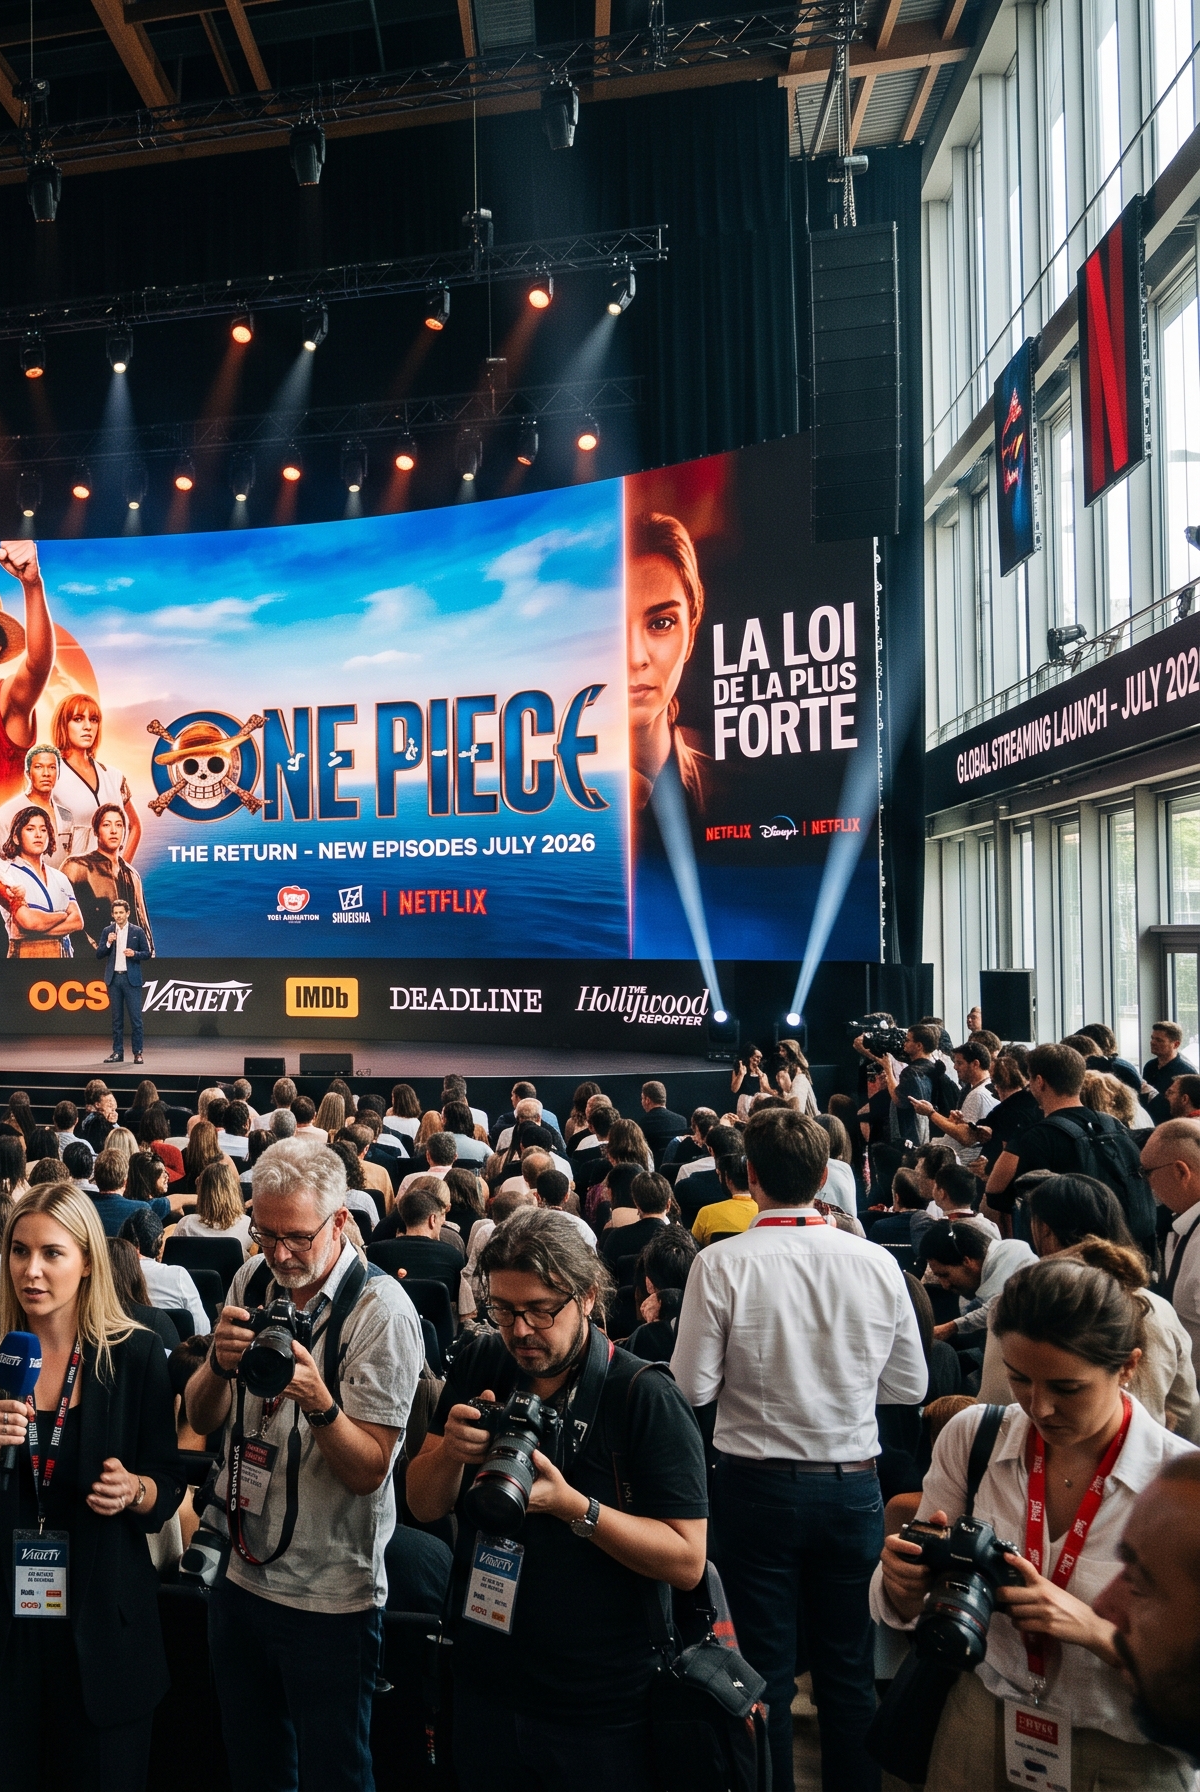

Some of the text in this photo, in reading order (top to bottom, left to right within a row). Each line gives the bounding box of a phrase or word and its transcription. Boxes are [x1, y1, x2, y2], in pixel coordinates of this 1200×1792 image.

[713, 602, 856, 676] LA LOI
[713, 661, 856, 705] DE LA PLUS
[714, 693, 858, 760] FORTE
[956, 741, 992, 784] GLOBAL
[991, 714, 1052, 771] STREAMING
[1053, 688, 1107, 747] LAUNCH
[1121, 662, 1162, 720] JULY
[1165, 646, 1200, 702] 202
[147, 683, 610, 824] ONE PIECE
[706, 824, 752, 841] NETFLIX
[811, 817, 861, 835] NETFLIX
[167, 845, 211, 863] THE
[214, 843, 298, 862] RETURN
[318, 841, 367, 860] NEW
[373, 838, 478, 859] EPISODES
[482, 835, 537, 856] JULY
[542, 833, 596, 854] 2026
[399, 889, 488, 915] NETFLIX
[332, 912, 371, 923] SHUEISHA
[29, 980, 110, 1011] OCS
[142, 979, 253, 1013] VARIETY
[295, 985, 349, 1008] IMDb
[389, 986, 543, 1013] DEADLINE
[575, 985, 709, 1023] Hollywood
[629, 984, 647, 995] THE
[637, 1013, 702, 1026] REPORTER
